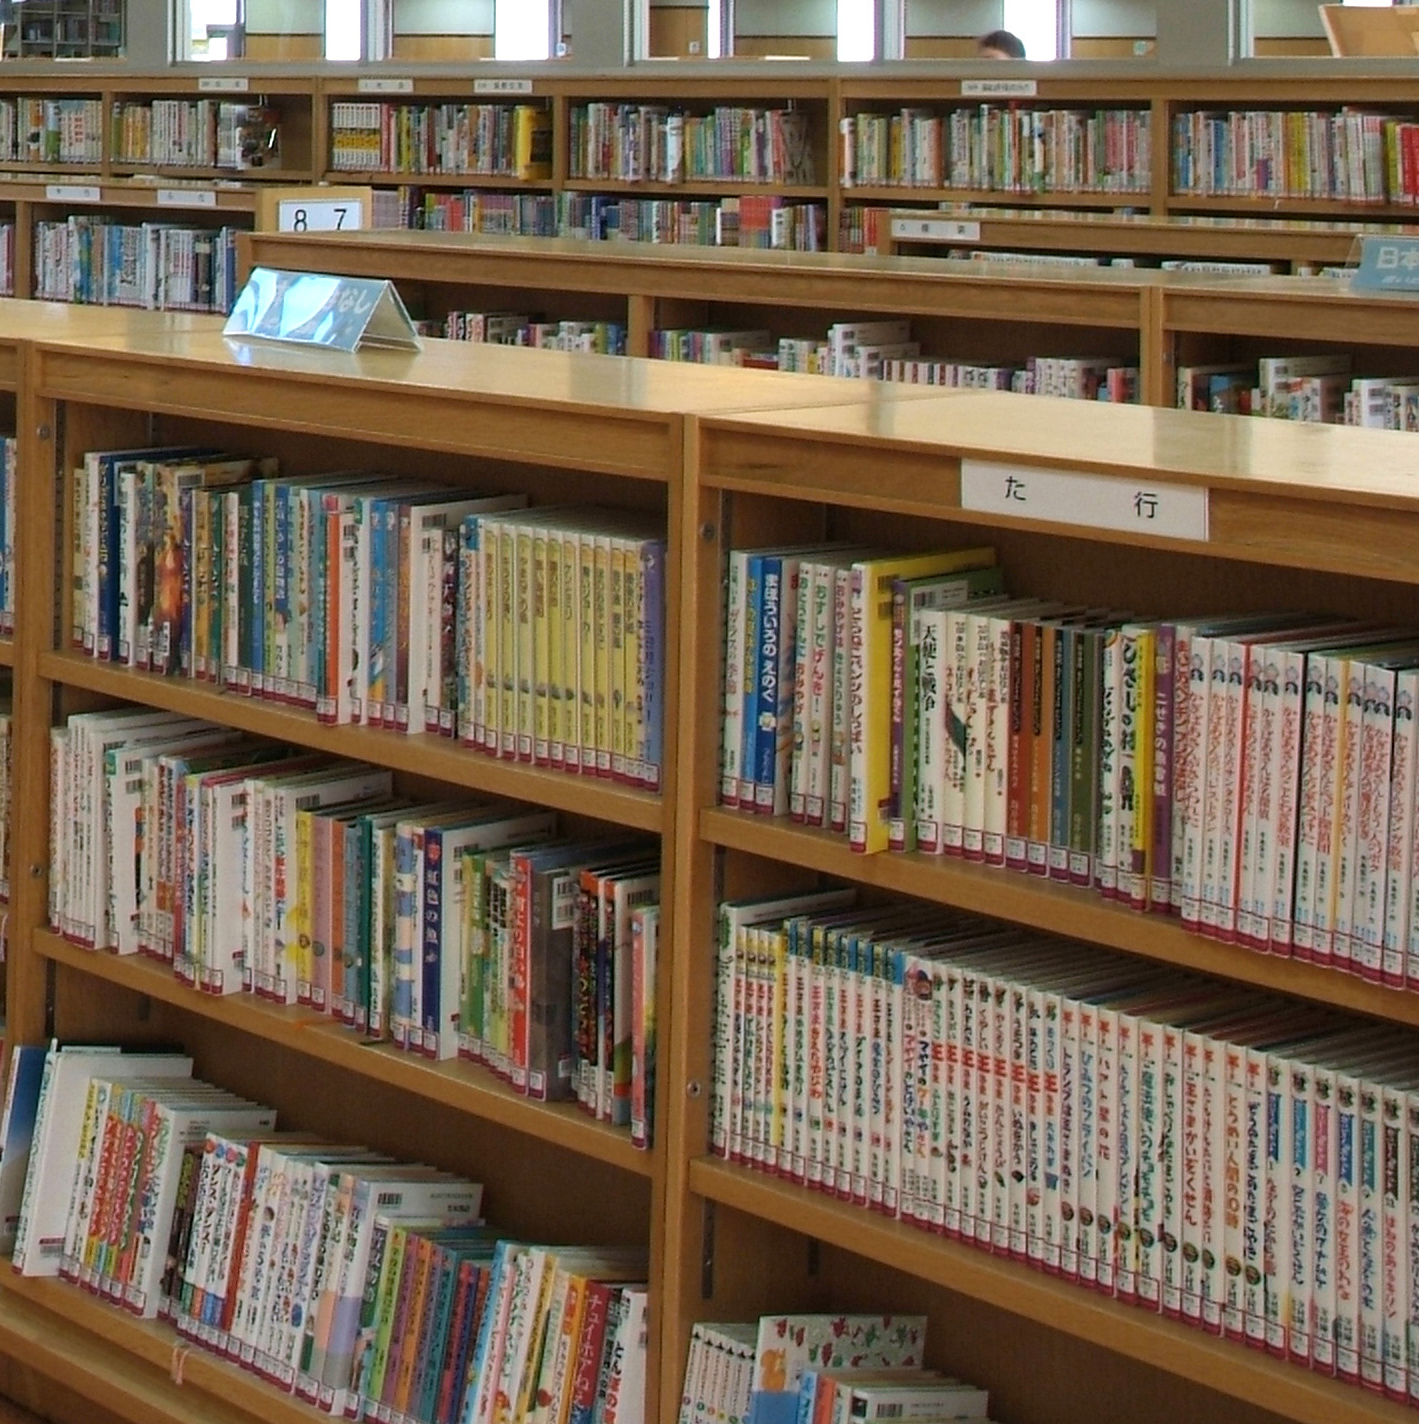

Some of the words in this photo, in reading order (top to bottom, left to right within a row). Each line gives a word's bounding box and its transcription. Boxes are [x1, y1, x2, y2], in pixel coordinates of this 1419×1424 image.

[293, 208, 308, 232] 8
[333, 208, 347, 230] 7
[1004, 475, 1027, 502] た
[1133, 491, 1159, 519] 行
